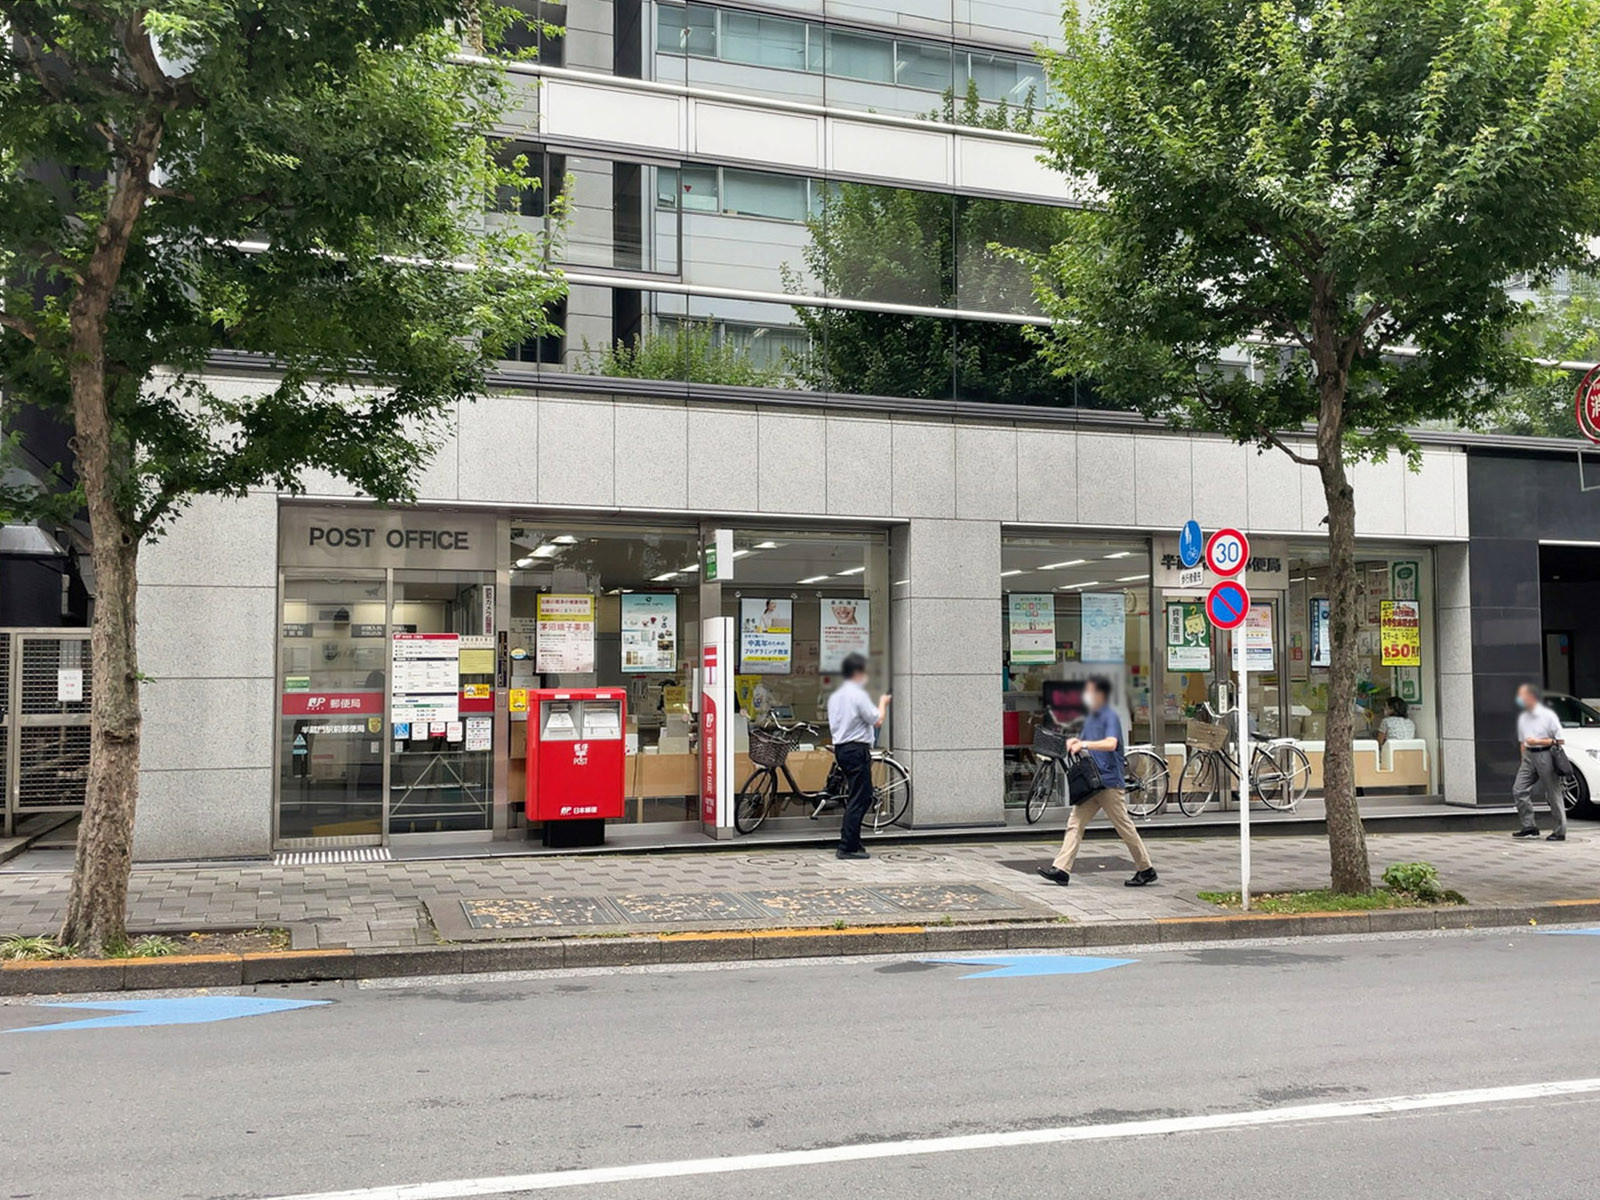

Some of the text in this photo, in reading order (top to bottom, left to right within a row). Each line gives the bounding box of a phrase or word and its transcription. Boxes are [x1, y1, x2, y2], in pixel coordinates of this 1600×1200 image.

[309, 526, 470, 550] POST OFFICE
[1216, 541, 1239, 564] 30
[329, 698, 361, 709] 郵便局
